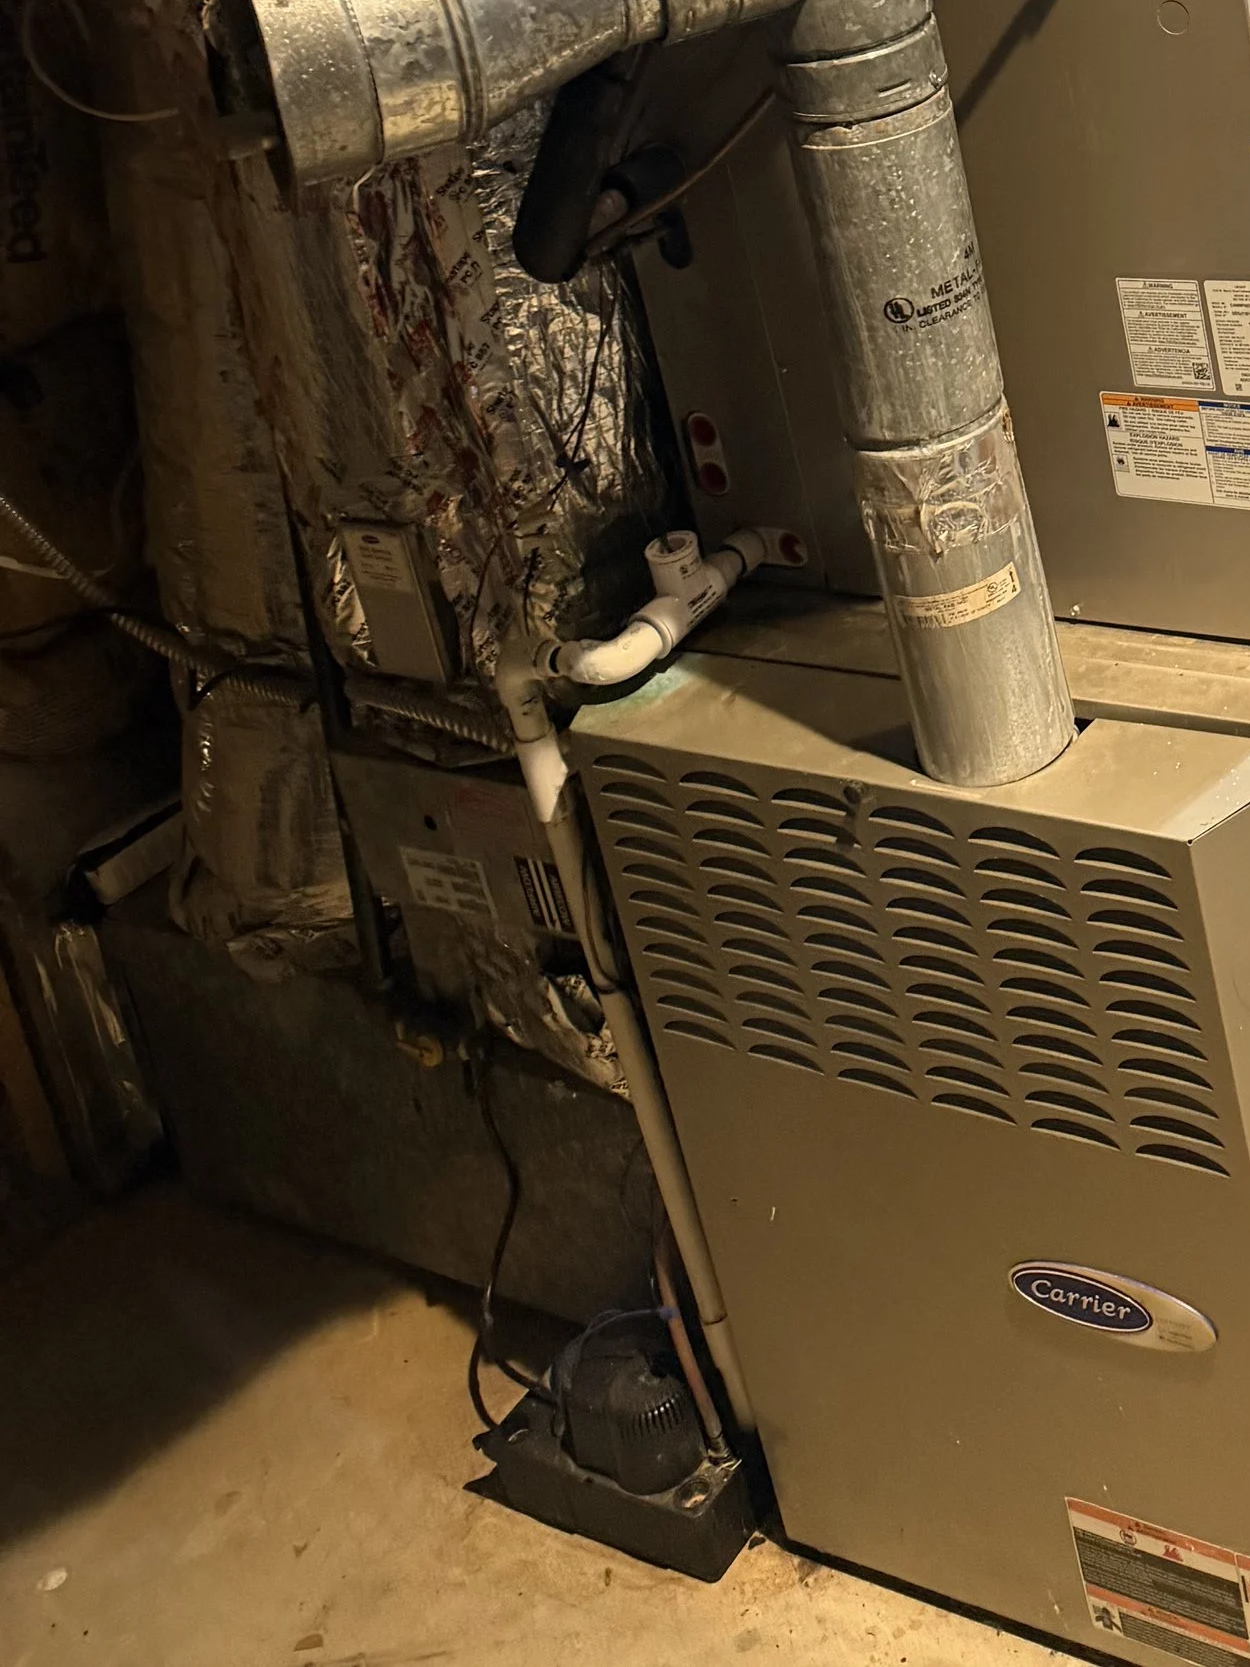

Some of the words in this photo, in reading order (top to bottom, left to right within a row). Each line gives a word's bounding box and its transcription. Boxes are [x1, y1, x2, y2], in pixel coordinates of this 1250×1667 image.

[916, 299, 951, 317] LISTED
[919, 300, 973, 329] CLEARANCE
[1030, 1278, 1131, 1320] Carrier
